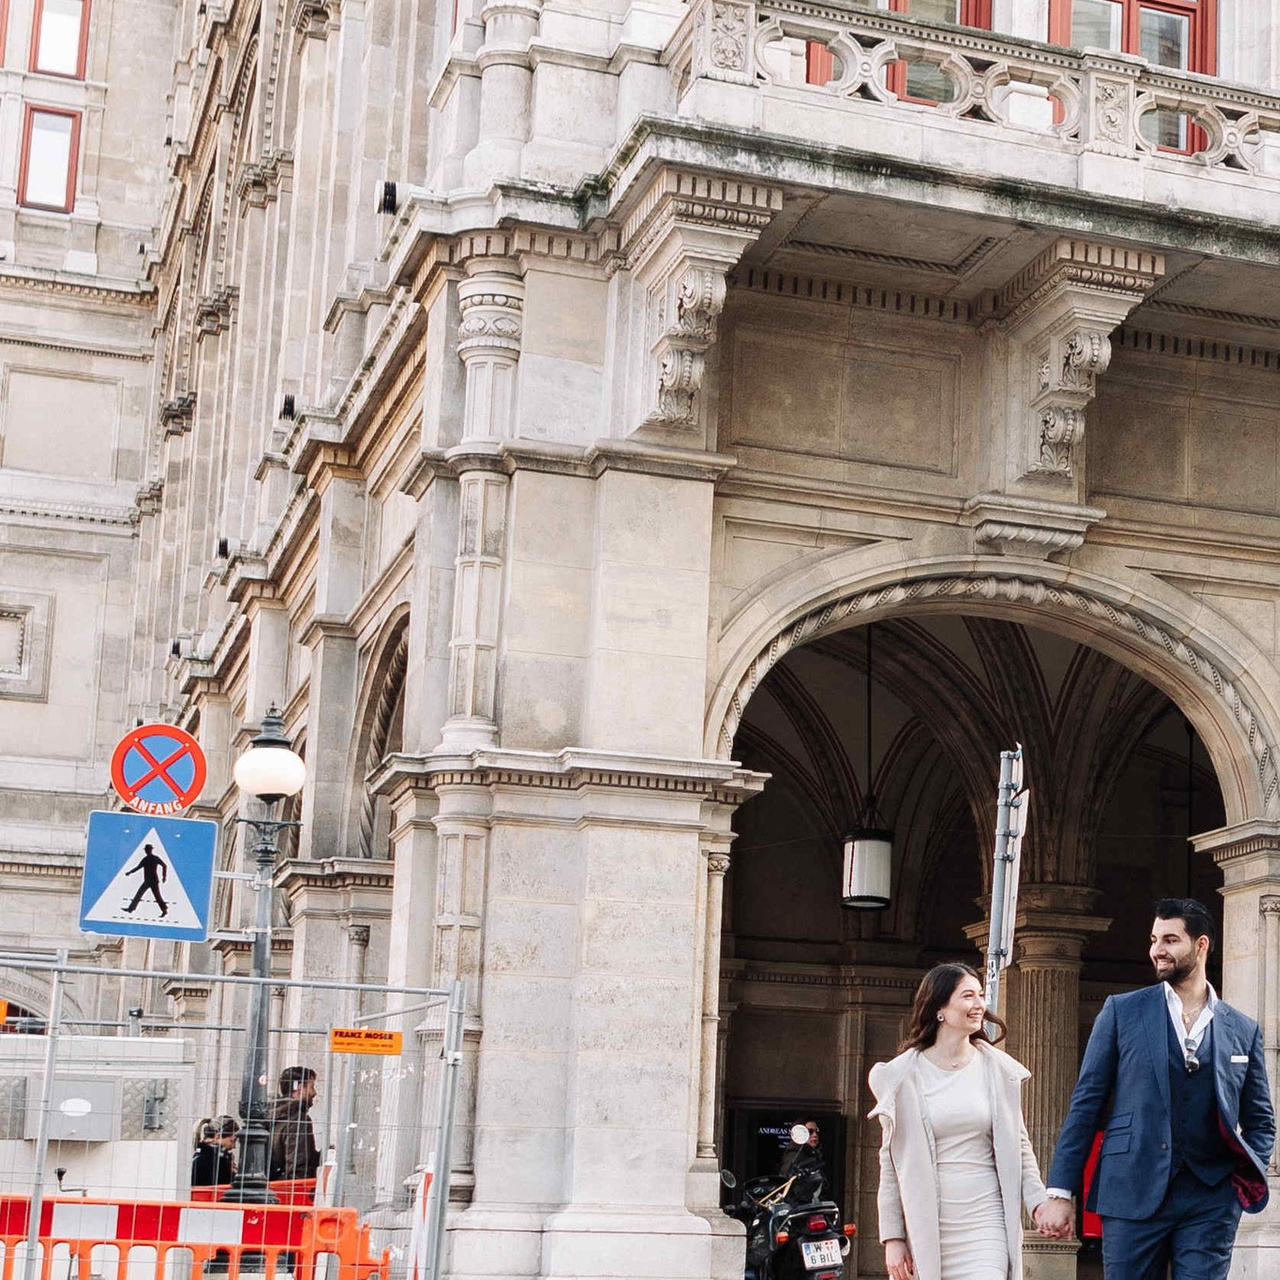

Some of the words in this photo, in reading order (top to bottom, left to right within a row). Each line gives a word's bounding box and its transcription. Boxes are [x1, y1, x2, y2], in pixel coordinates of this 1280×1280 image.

[129, 796, 183, 814] ANFANG
[334, 1030, 363, 1039] FRANZ
[364, 1032, 394, 1041] MOSER
[758, 1127, 788, 1135] ANDREAS
[814, 1242, 822, 1253] W
[810, 1254, 817, 1265] 6
[819, 1252, 836, 1264] BIL
